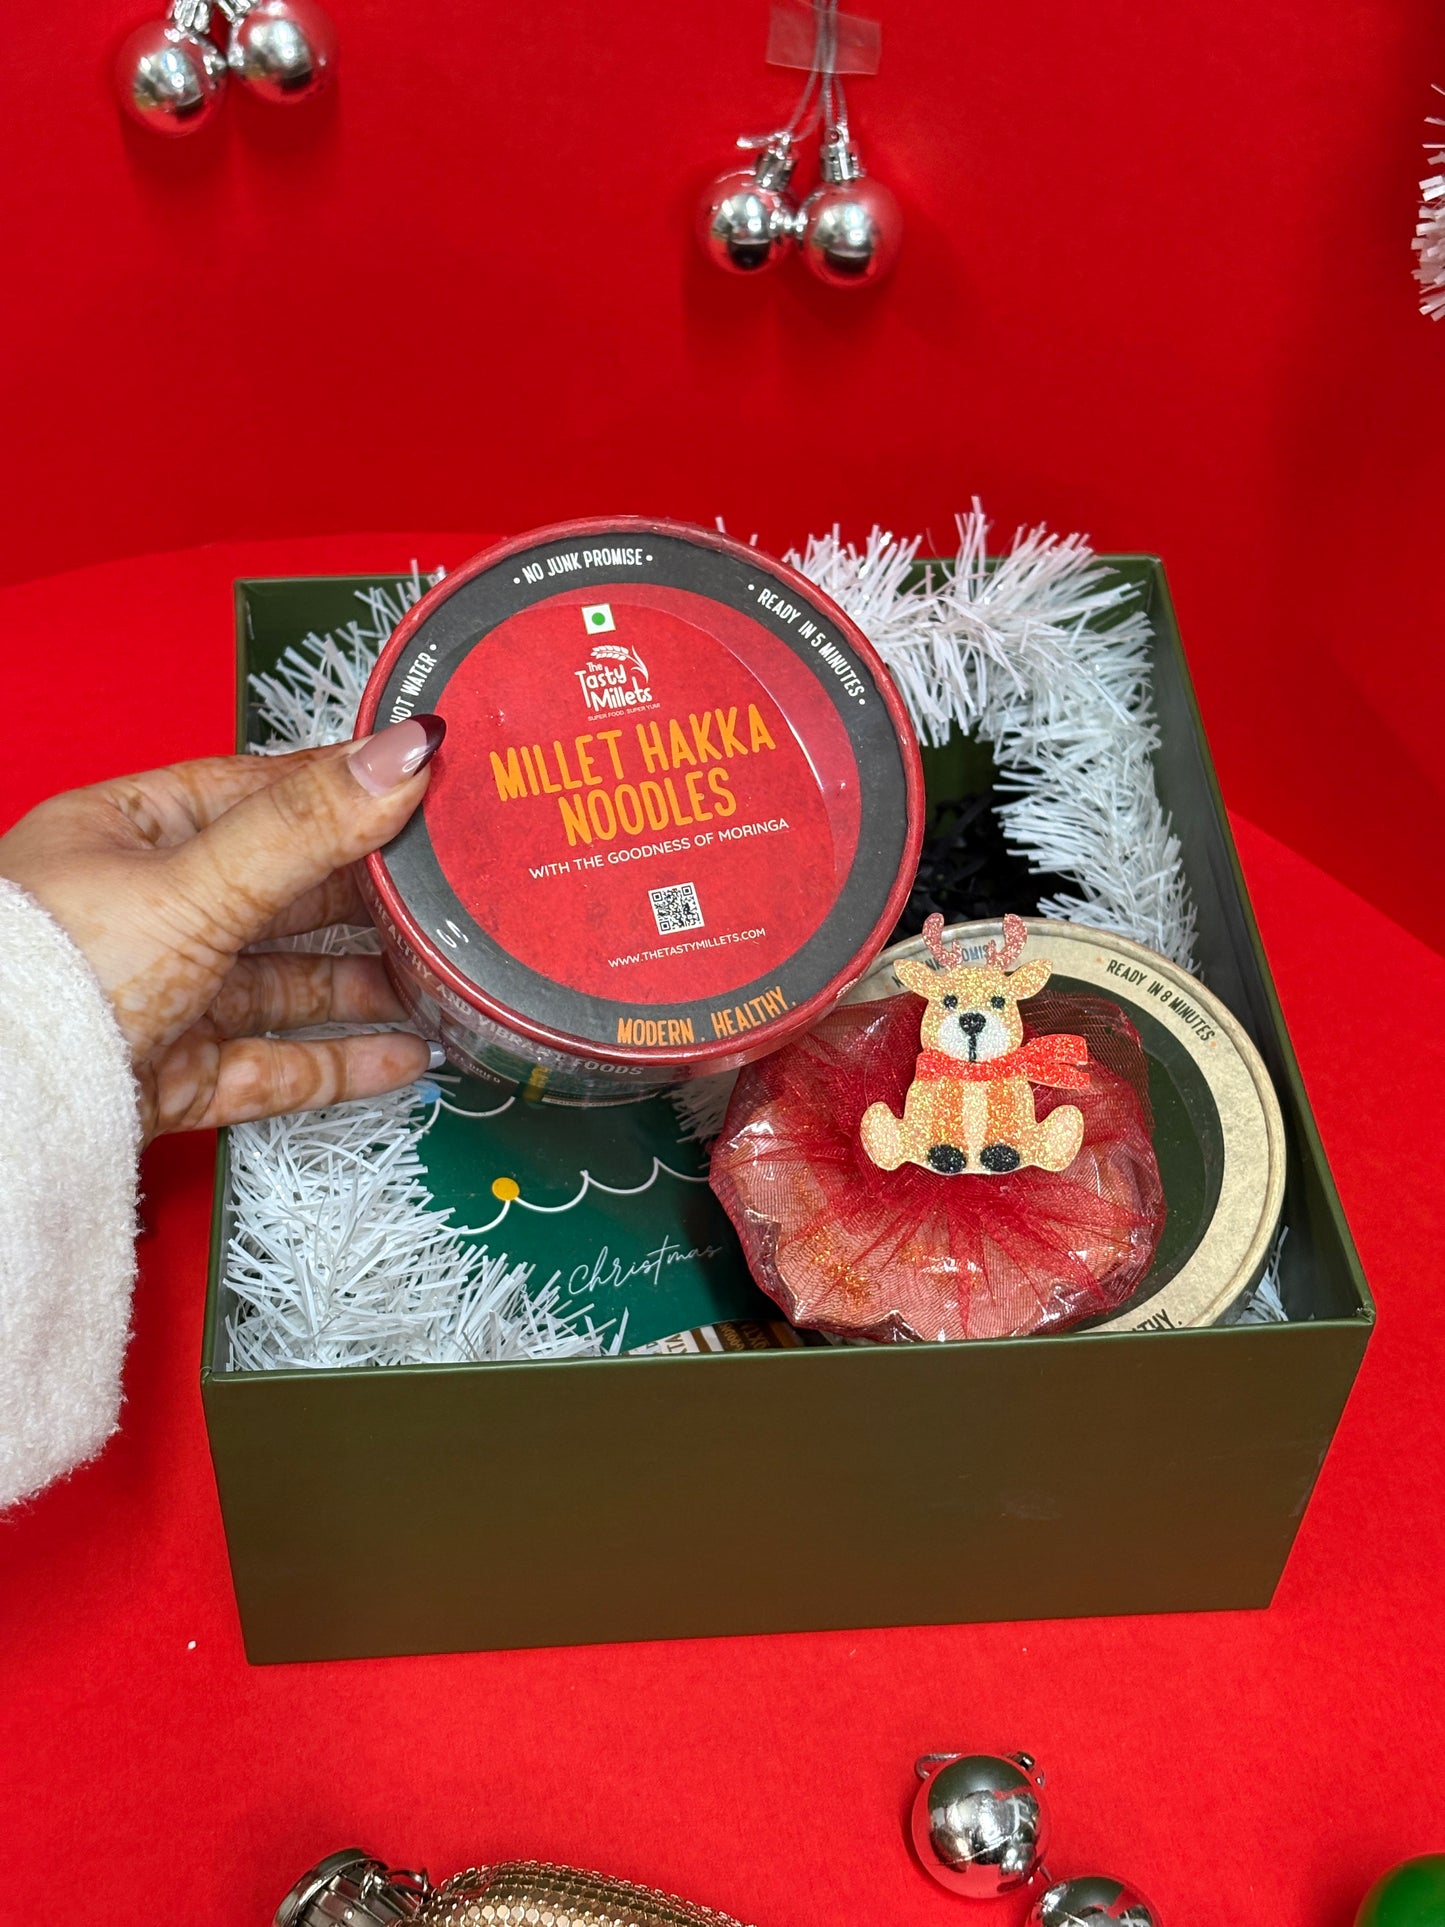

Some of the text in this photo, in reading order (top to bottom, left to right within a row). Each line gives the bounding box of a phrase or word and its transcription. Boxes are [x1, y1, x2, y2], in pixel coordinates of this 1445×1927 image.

[522, 548, 643, 584] NO JUNK PROMISE
[757, 588, 865, 697] READY IN 5 MINUTES
[400, 652, 437, 696] WATER
[574, 664, 627, 708] Tasty
[586, 662, 603, 672] The
[590, 676, 653, 712] Millets
[489, 703, 776, 802] MILLET HAKKA
[558, 767, 737, 846] NOODLES
[529, 818, 790, 879] WITH THE GOODNESS OF MORINGA
[608, 927, 766, 968] WWW.THETASTYMILLETS.COM
[1106, 959, 1215, 1042] READY IN 8 MINUTES
[573, 1057, 645, 1076] FOODS
